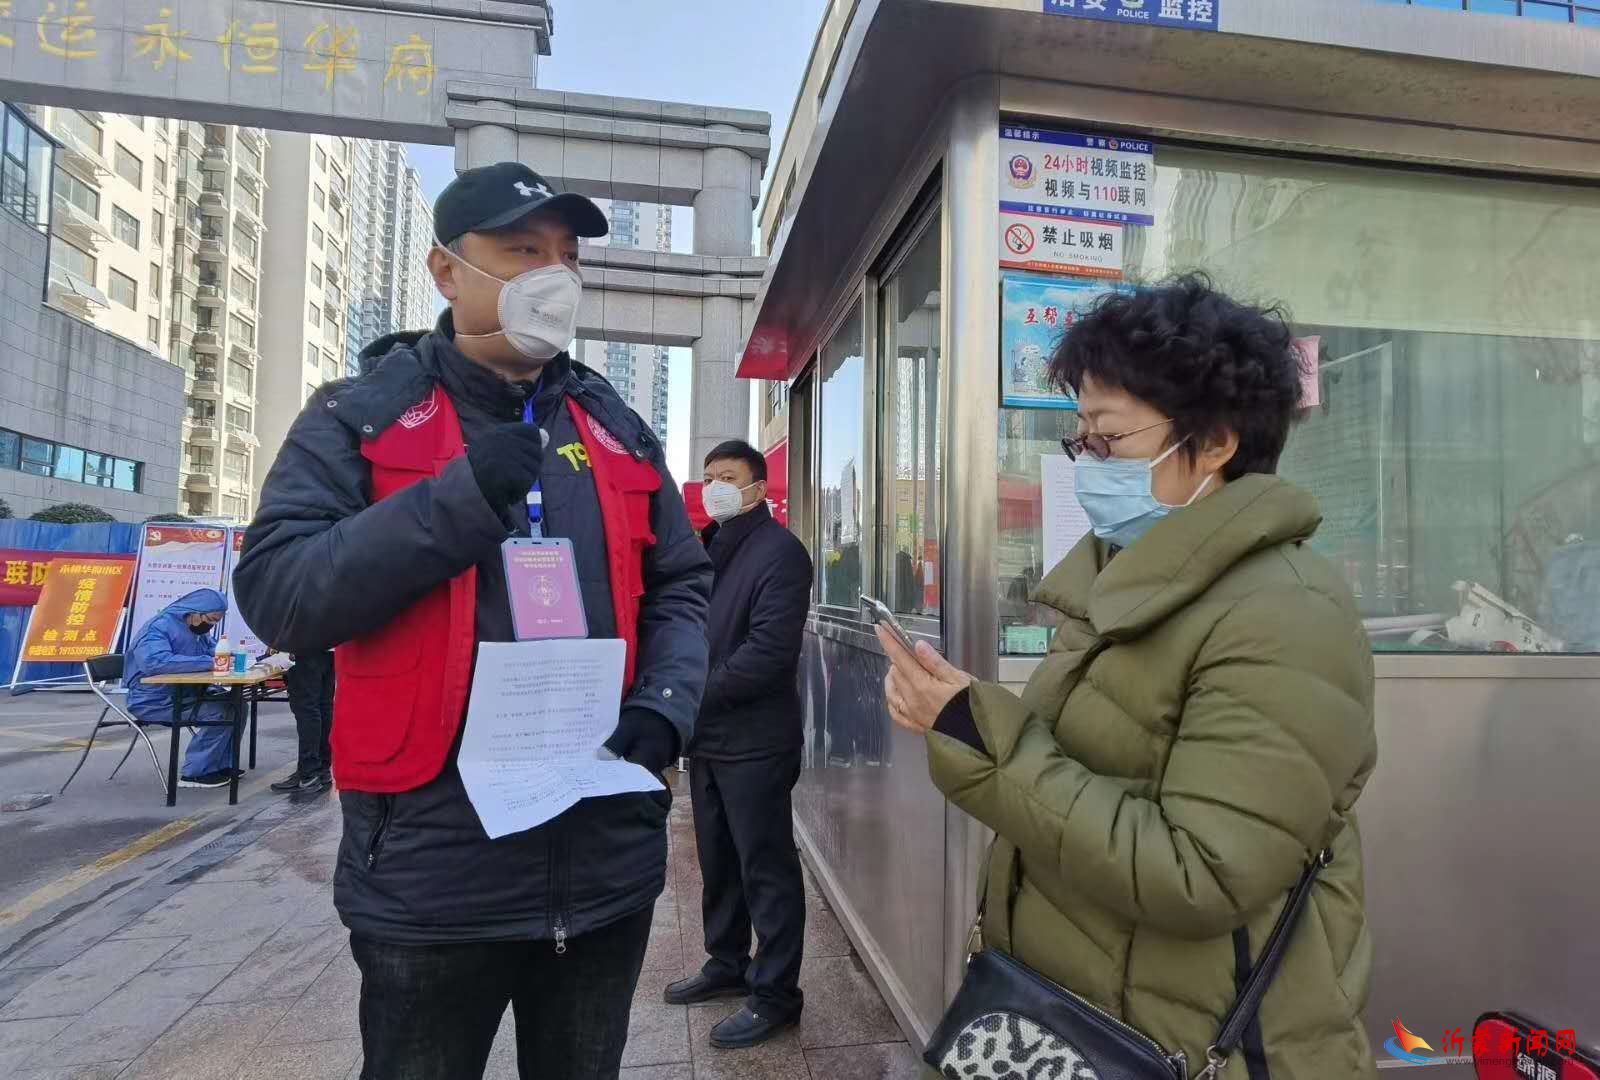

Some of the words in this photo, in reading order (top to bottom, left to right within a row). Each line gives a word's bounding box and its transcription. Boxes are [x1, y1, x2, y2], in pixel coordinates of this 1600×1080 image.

[1116, 8, 1149, 19] POLICE
[1004, 128, 1040, 140] 温馨提示
[1120, 141, 1149, 152] POLICE
[1044, 154, 1147, 181] 24小时视频监控
[1045, 178, 1146, 207] 视频与110联网
[1042, 225, 1113, 252] 禁止吸烟
[1053, 250, 1065, 259] NO
[1069, 253, 1103, 263] SMOKING
[66, 578, 97, 626] 疫情防控
